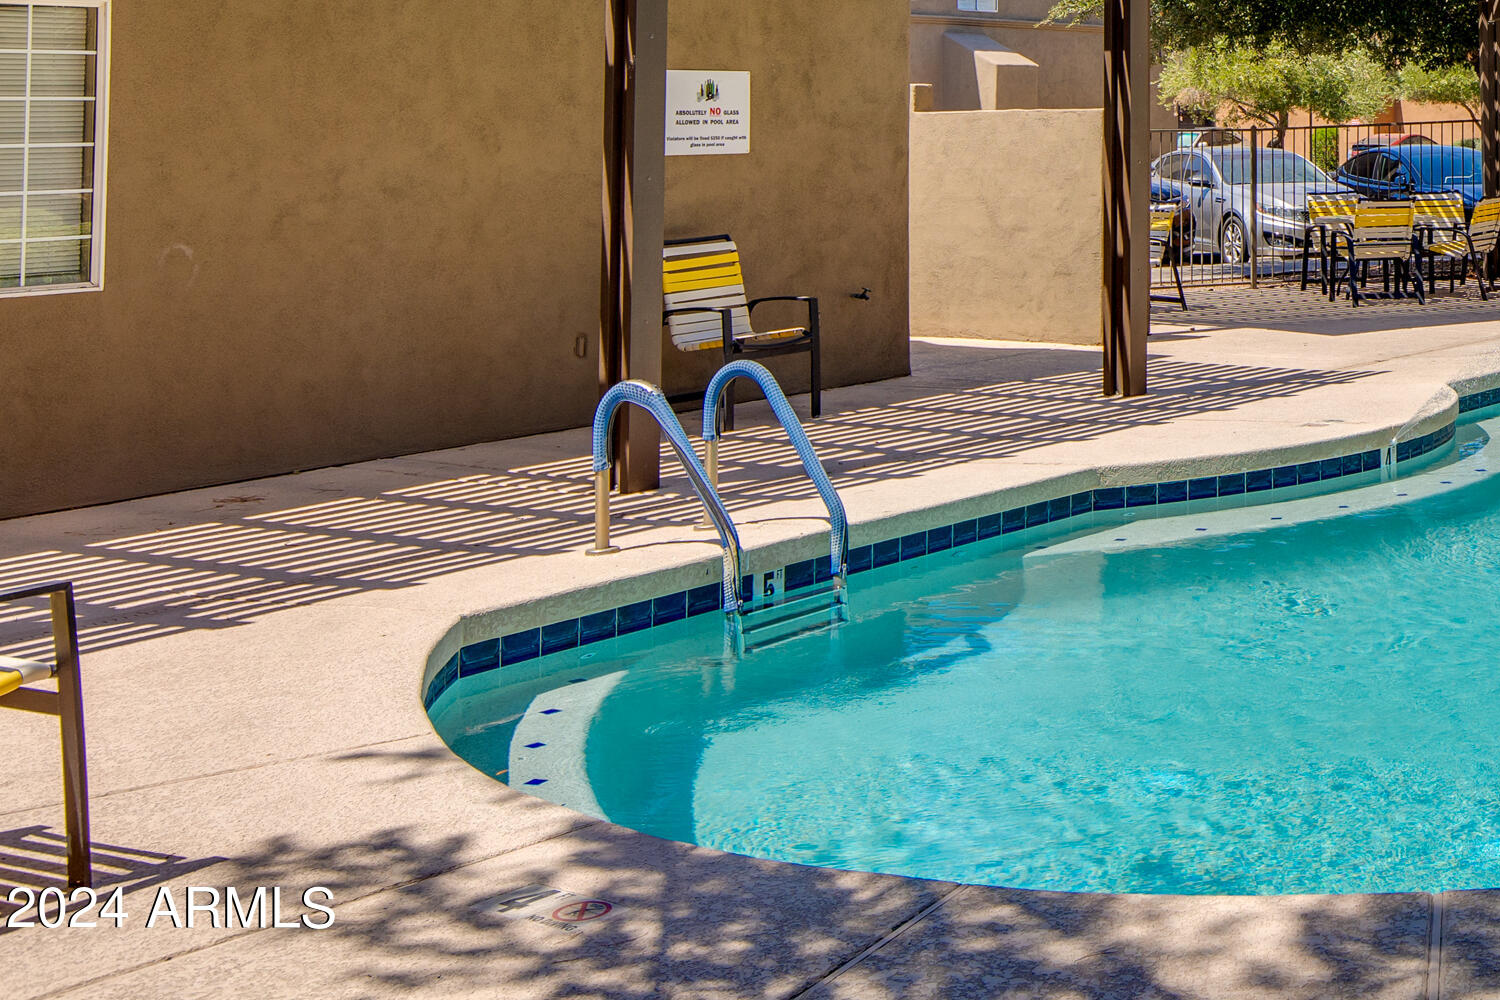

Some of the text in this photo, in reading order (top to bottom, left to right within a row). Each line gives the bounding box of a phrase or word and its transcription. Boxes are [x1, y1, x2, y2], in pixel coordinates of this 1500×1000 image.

[709, 107, 721, 116] NO
[763, 571, 775, 597] 5
[497, 889, 561, 913] 4
